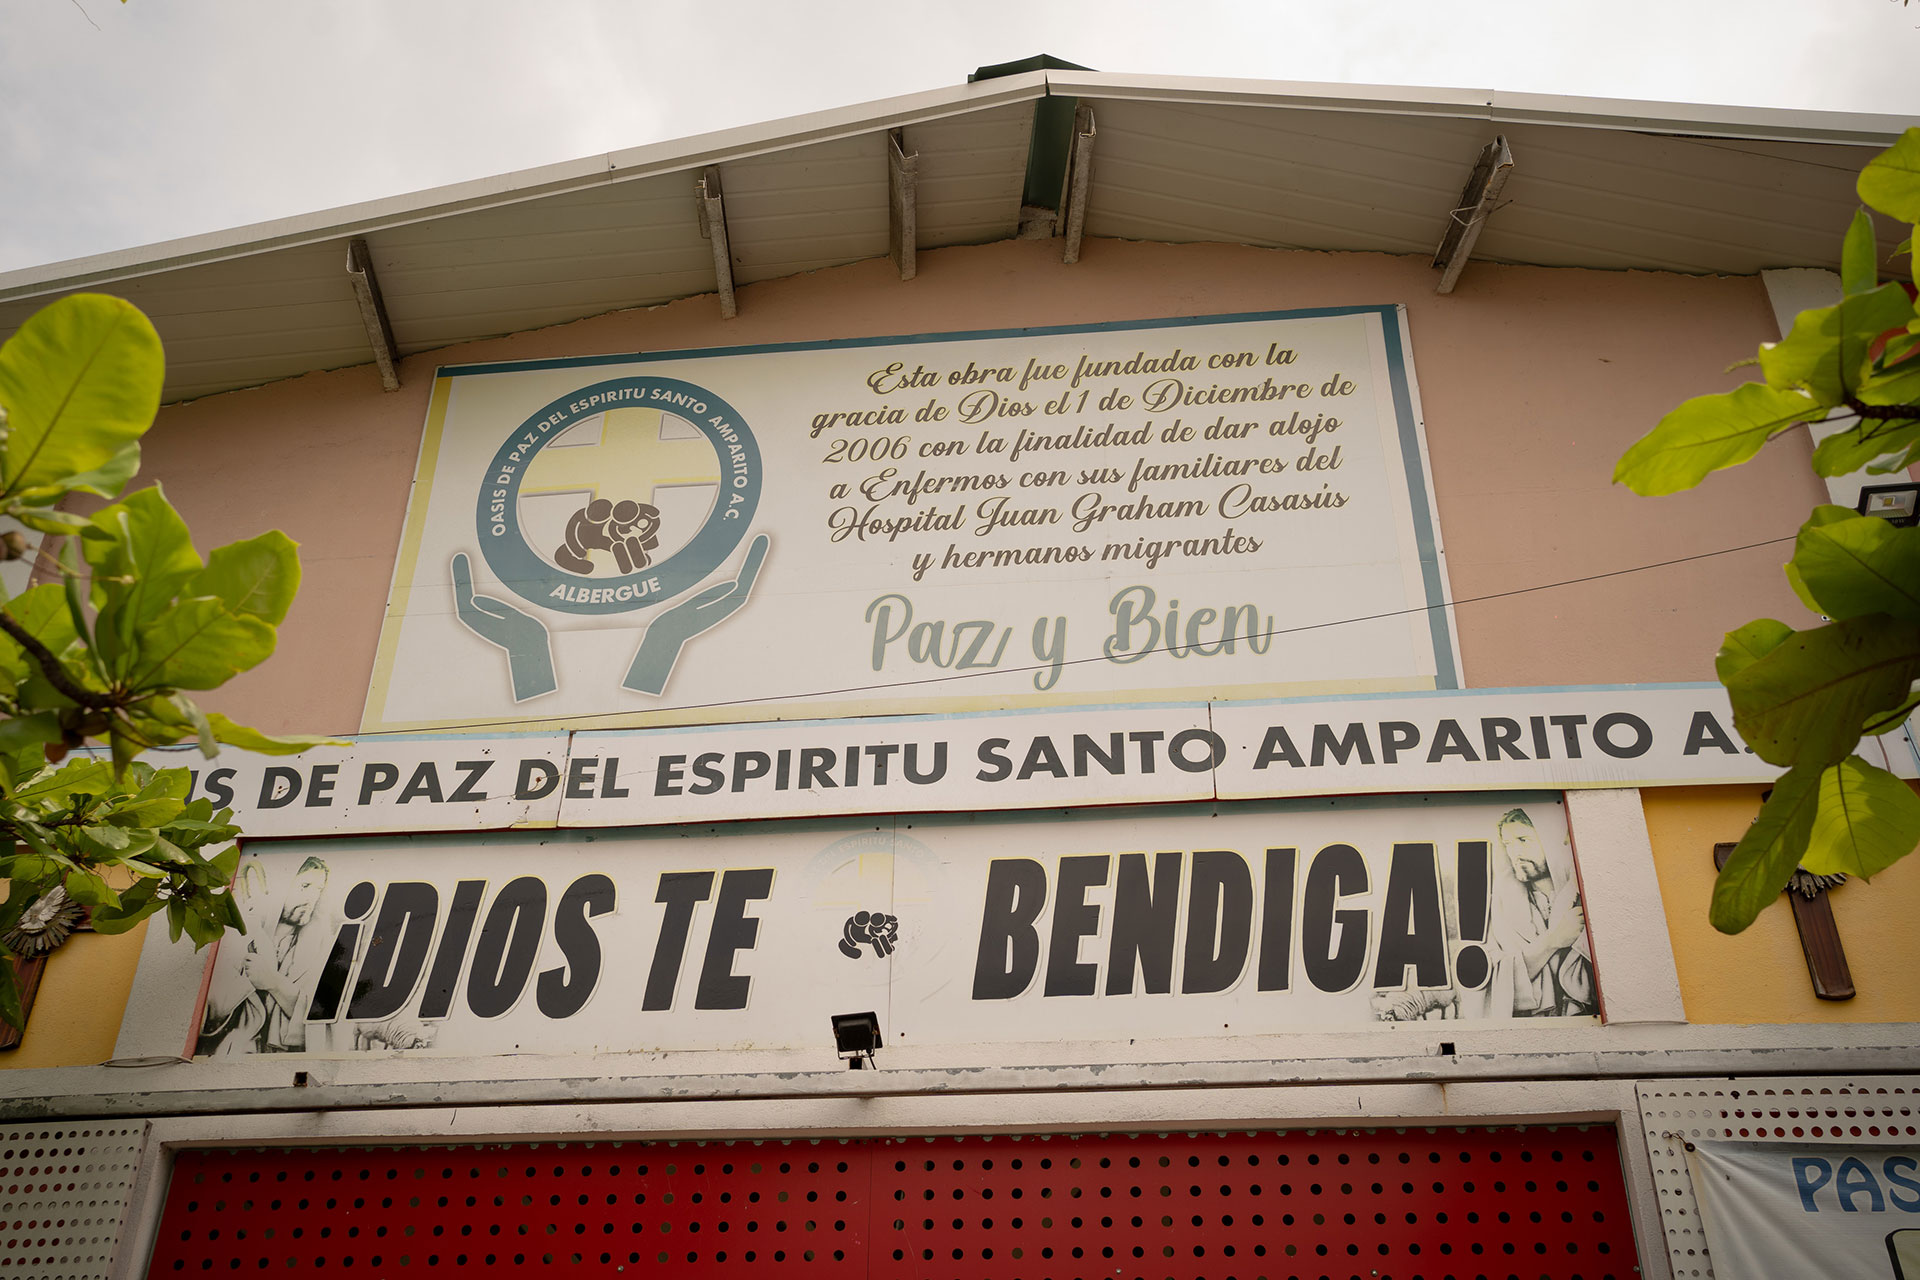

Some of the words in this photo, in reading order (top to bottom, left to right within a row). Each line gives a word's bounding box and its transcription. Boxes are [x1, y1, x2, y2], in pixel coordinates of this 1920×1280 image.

[867, 362, 942, 394] Esta
[948, 362, 1017, 386] obra
[1018, 358, 1068, 391] fue
[1070, 349, 1201, 389] fundada
[1207, 350, 1259, 370] con
[1265, 342, 1298, 366] la
[537, 410, 569, 433] DEL
[569, 388, 646, 414] ESPIRITU
[650, 388, 708, 415] SANTO
[809, 404, 908, 439] gracia
[914, 398, 951, 423] de
[957, 389, 1038, 425] Dios
[1044, 390, 1072, 416] el
[1075, 389, 1091, 414] 1
[1098, 387, 1135, 412] de
[1142, 377, 1313, 413] Diciembre
[1319, 373, 1357, 397] de
[509, 432, 540, 462] PAZ
[708, 415, 749, 489] AMPARITO
[822, 434, 911, 464] 2006
[918, 440, 970, 459] con
[975, 430, 1008, 455] la
[1009, 420, 1155, 463] finalidad
[1160, 418, 1198, 443] de
[1203, 415, 1260, 441] dar
[1268, 411, 1344, 445] alojo
[497, 465, 516, 485] DE
[828, 483, 852, 501] a
[859, 467, 1013, 506] Enfermos
[1019, 470, 1072, 489] con
[1076, 466, 1127, 486] sus
[1127, 453, 1290, 494] familiares
[1295, 445, 1344, 472] del
[491, 489, 507, 537] OASIS
[722, 492, 745, 521] A.C.
[827, 503, 967, 544] Hospital
[974, 496, 1064, 537] Juan
[1071, 492, 1211, 533] Graham
[1218, 482, 1350, 520] Casasús
[911, 553, 936, 582] y
[940, 544, 1095, 571] hermanos
[1101, 528, 1264, 570] migrantes
[549, 577, 661, 603] ALBERGUE
[864, 593, 1014, 672] Paz
[1031, 614, 1067, 691] y
[1102, 585, 1274, 665] Bien
[256, 764, 340, 811] DE
[357, 760, 496, 806] PAZ
[514, 757, 629, 801] DEL
[653, 741, 949, 797] ESPIRITU
[975, 728, 1227, 783] SANTO
[1252, 711, 1653, 770] AMPARITO
[304, 873, 617, 1023] ¡DIOS
[641, 867, 777, 1012] TE
[971, 839, 1493, 1001] BENDIGA!
